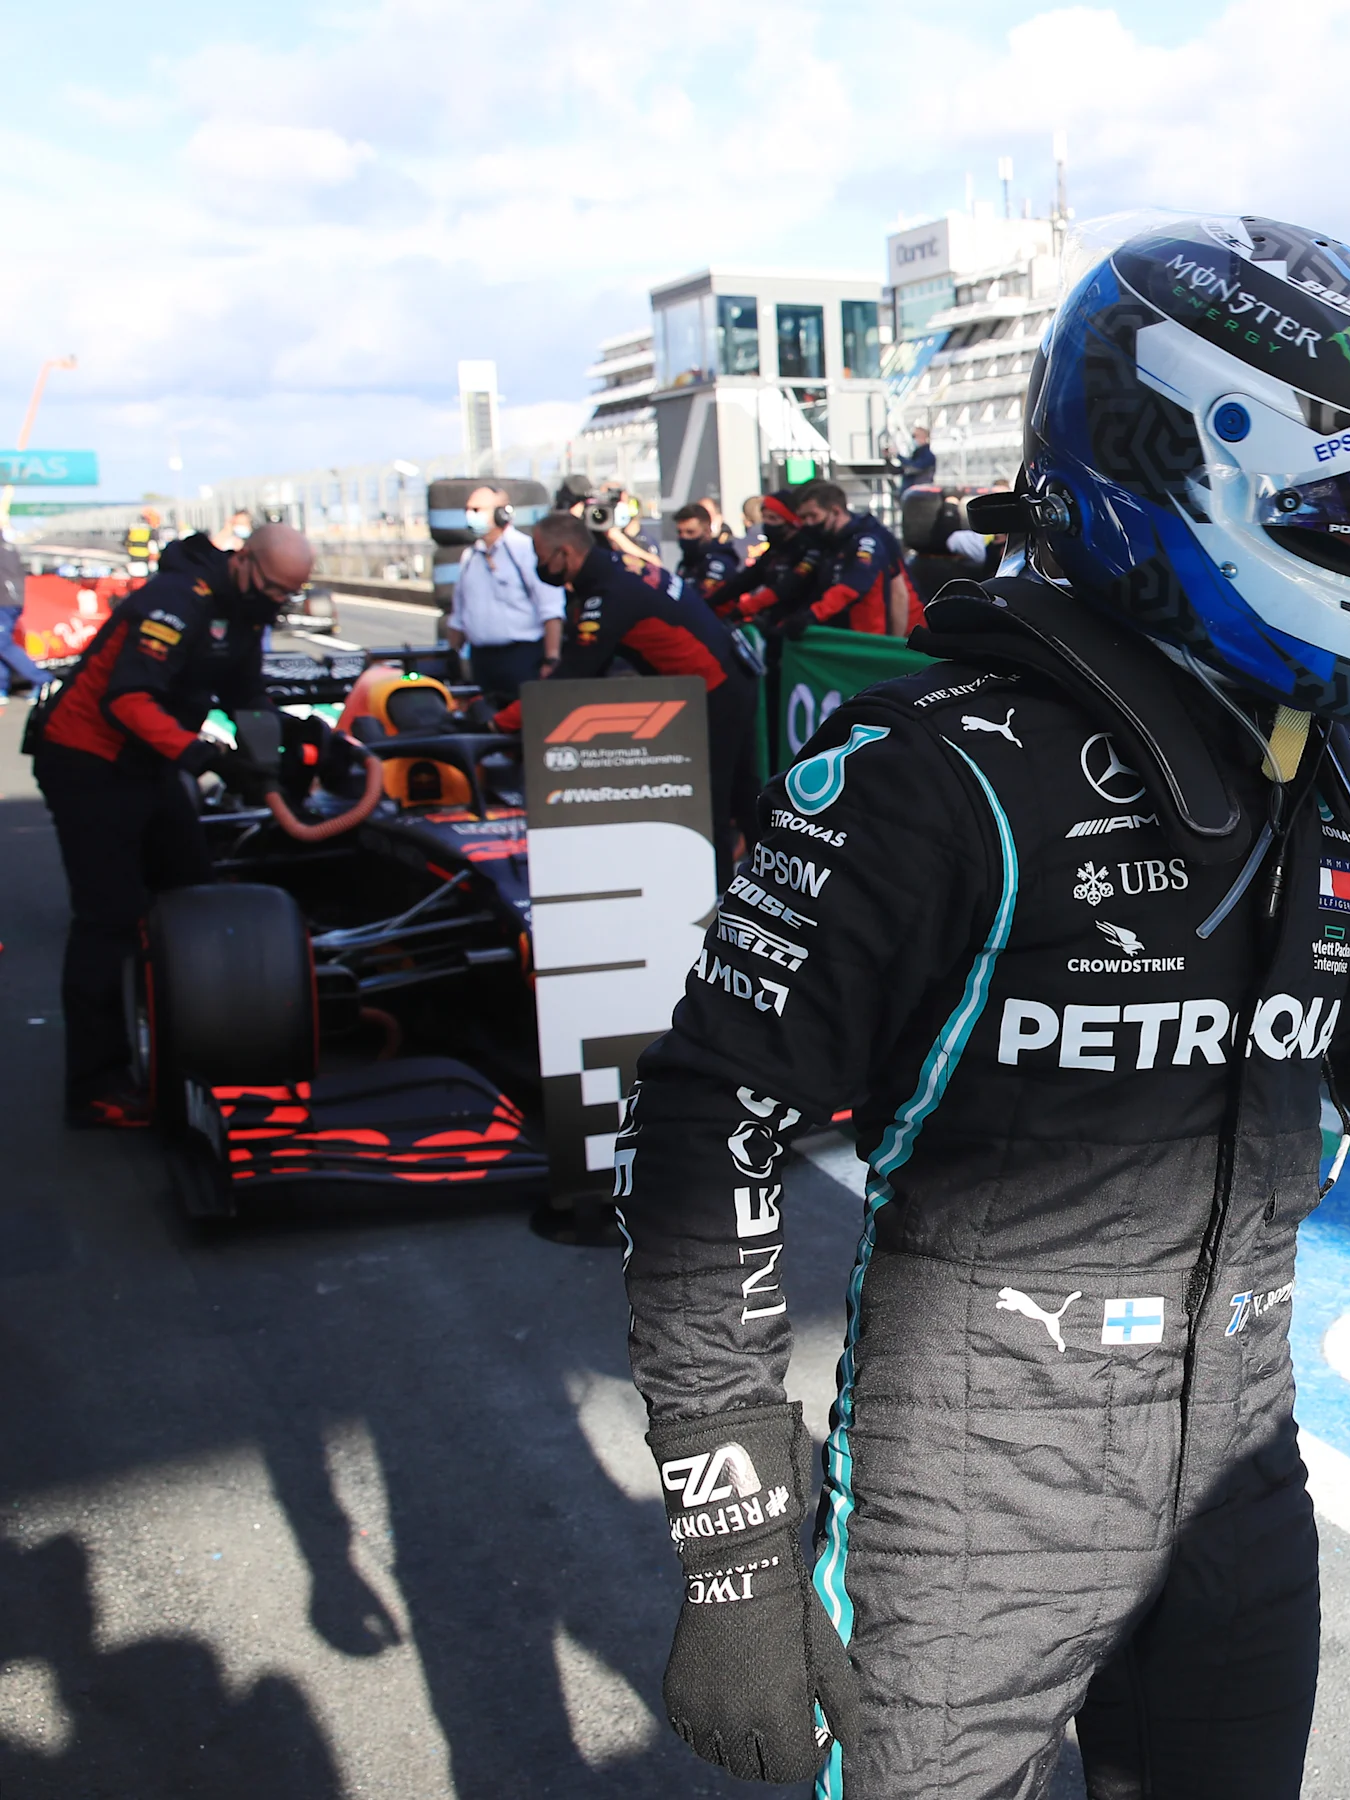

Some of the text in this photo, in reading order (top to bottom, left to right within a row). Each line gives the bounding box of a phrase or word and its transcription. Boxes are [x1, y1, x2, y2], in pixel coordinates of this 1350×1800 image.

[1172, 285, 1283, 353] ENERGY
[914, 689, 951, 707] THE
[545, 752, 577, 767] FIA
[599, 748, 642, 758] Formula
[581, 754, 684, 768] World Championship
[562, 783, 693, 804] #WeRaceAsOne
[751, 842, 832, 898] EPSON
[1117, 858, 1189, 895] UBS
[727, 875, 818, 929] BOSE
[692, 949, 753, 1000] AMD
[1067, 957, 1185, 974] CROWDSTRIKE
[998, 993, 1342, 1072] PETRONA
[688, 1572, 754, 1605] IWC
